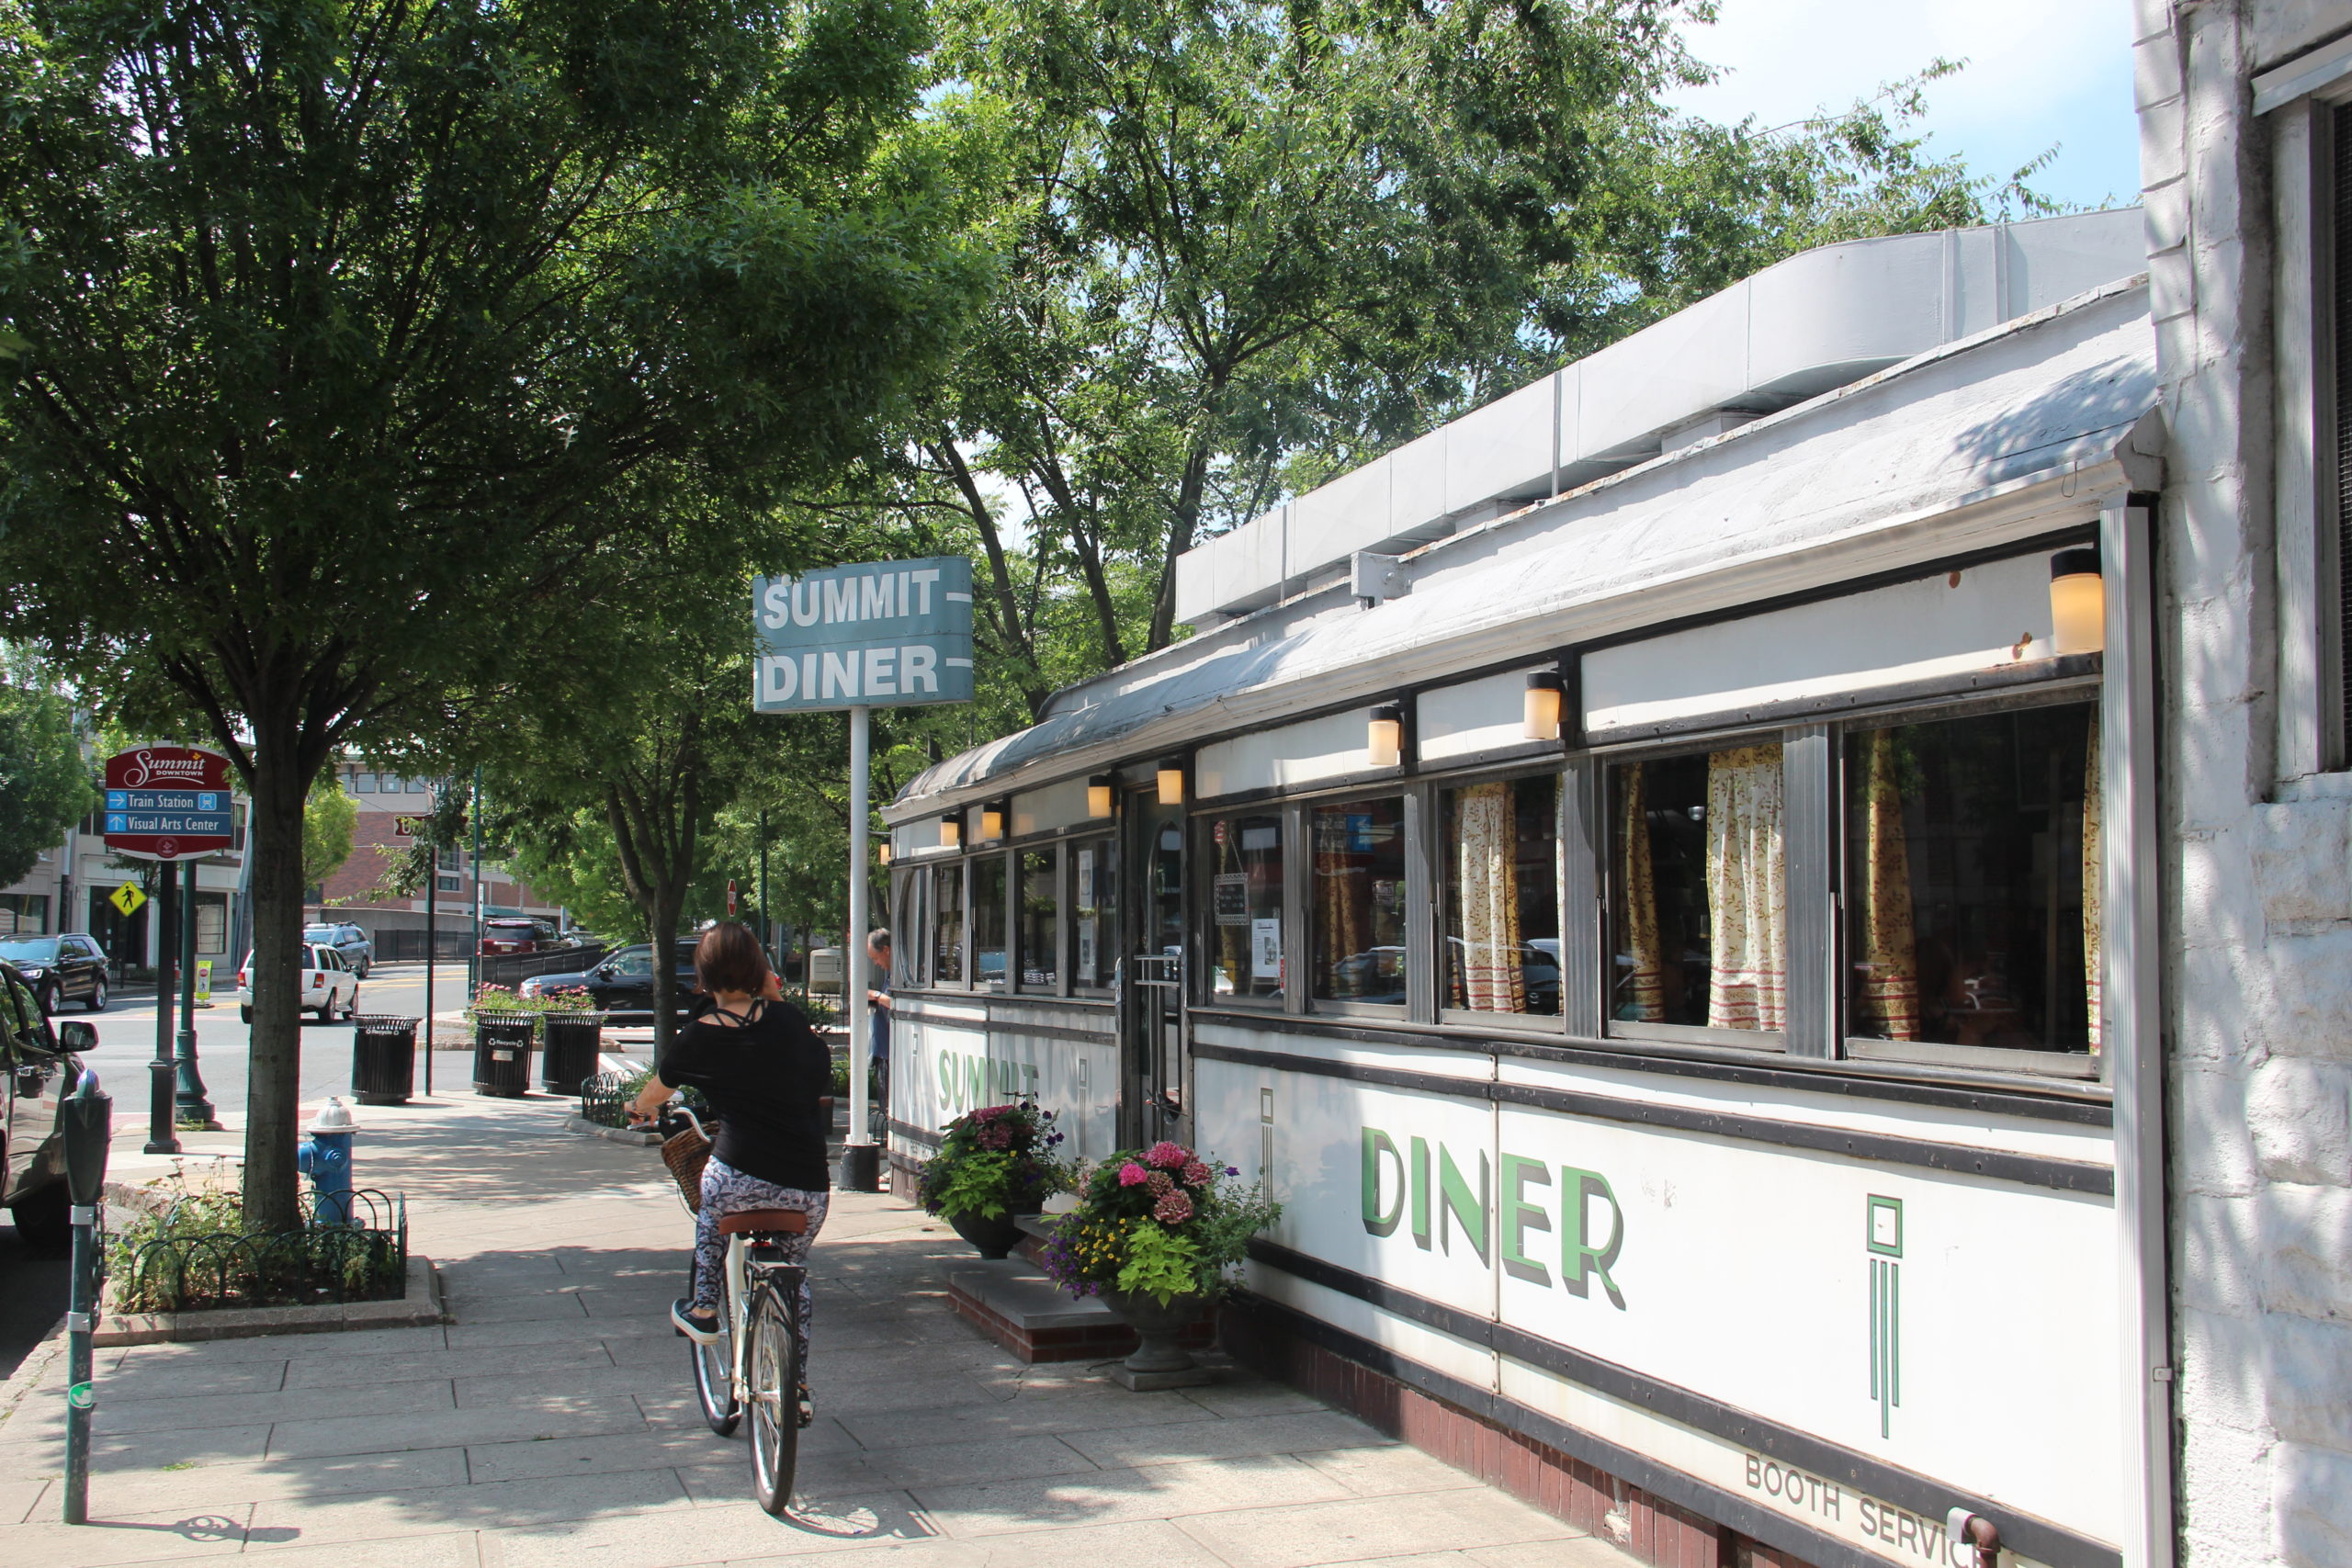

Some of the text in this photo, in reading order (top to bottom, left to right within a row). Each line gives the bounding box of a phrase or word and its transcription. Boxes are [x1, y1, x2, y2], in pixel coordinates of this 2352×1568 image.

[763, 569, 940, 630] SUMMIT
[763, 645, 939, 703] DINER
[124, 750, 206, 787] Summit
[129, 794, 194, 808] Train Station
[129, 817, 220, 831] Visual Arts Center
[1362, 1125, 1627, 1312] DINER
[1746, 1453, 1840, 1521] BOOTH
